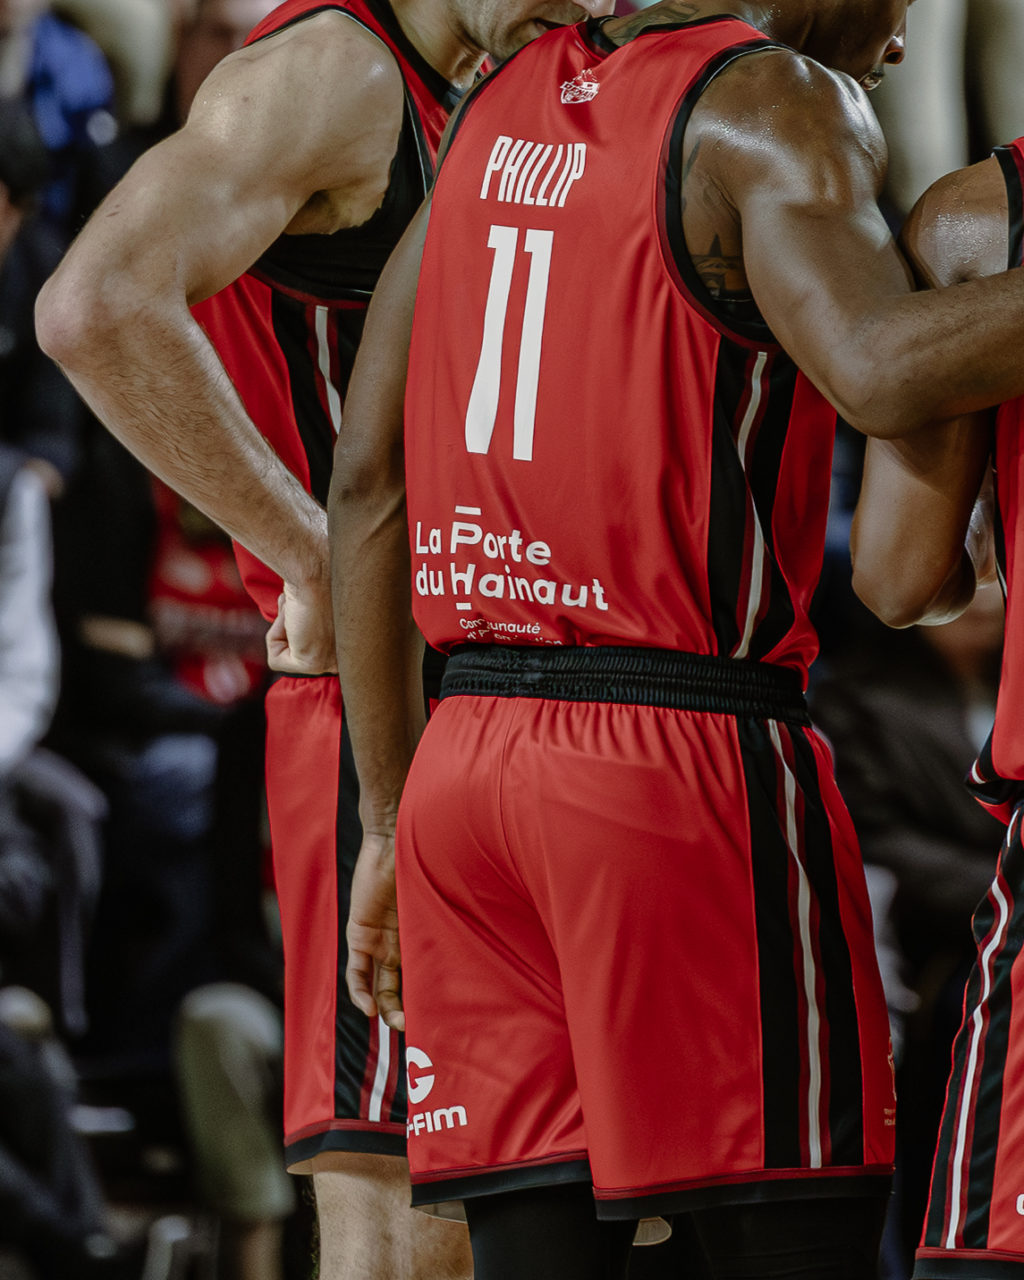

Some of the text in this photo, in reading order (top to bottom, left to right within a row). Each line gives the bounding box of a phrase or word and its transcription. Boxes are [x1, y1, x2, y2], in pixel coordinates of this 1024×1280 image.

[480, 135, 587, 208] PHILLIP
[464, 224, 554, 462] 11
[415, 521, 551, 566] La Porte
[415, 562, 609, 611] du Hainaut
